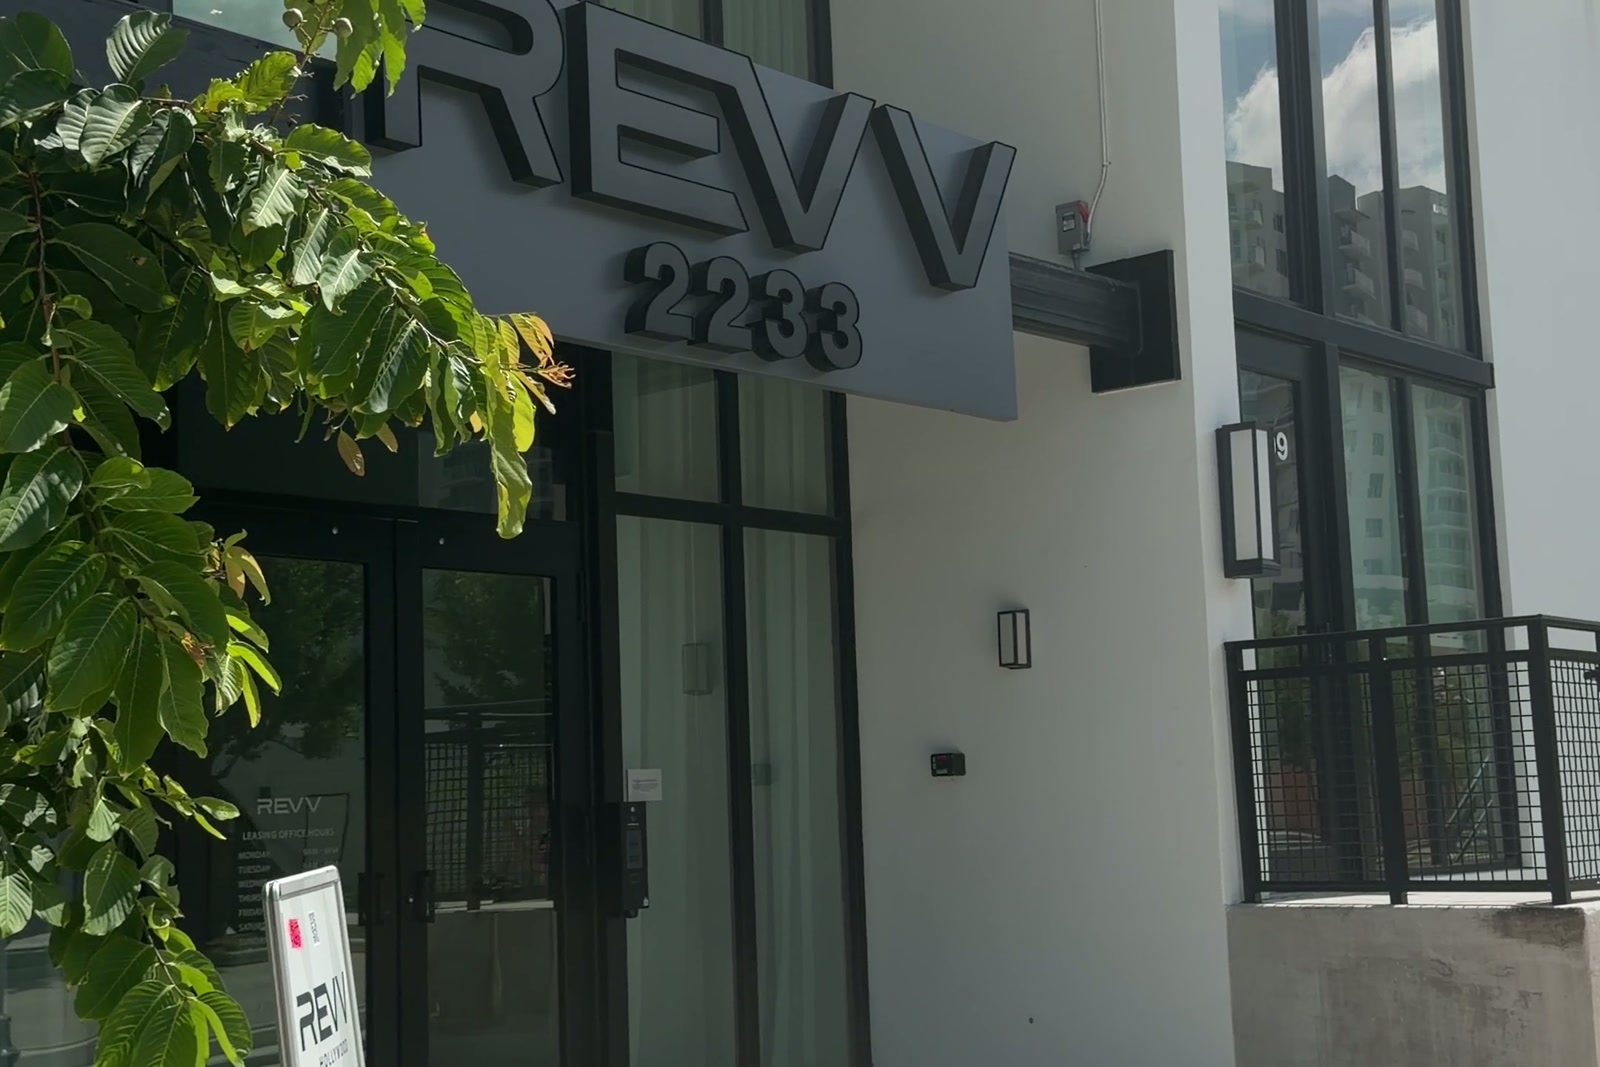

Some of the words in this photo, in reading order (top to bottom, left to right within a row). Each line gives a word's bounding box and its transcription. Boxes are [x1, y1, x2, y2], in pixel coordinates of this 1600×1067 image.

[366, 0, 1017, 290] REVV
[626, 241, 863, 372] 2233
[242, 830, 277, 840] LEASING
[278, 829, 306, 838] OFFICE
[257, 796, 322, 814] REVV
[296, 971, 347, 1052] REVV
